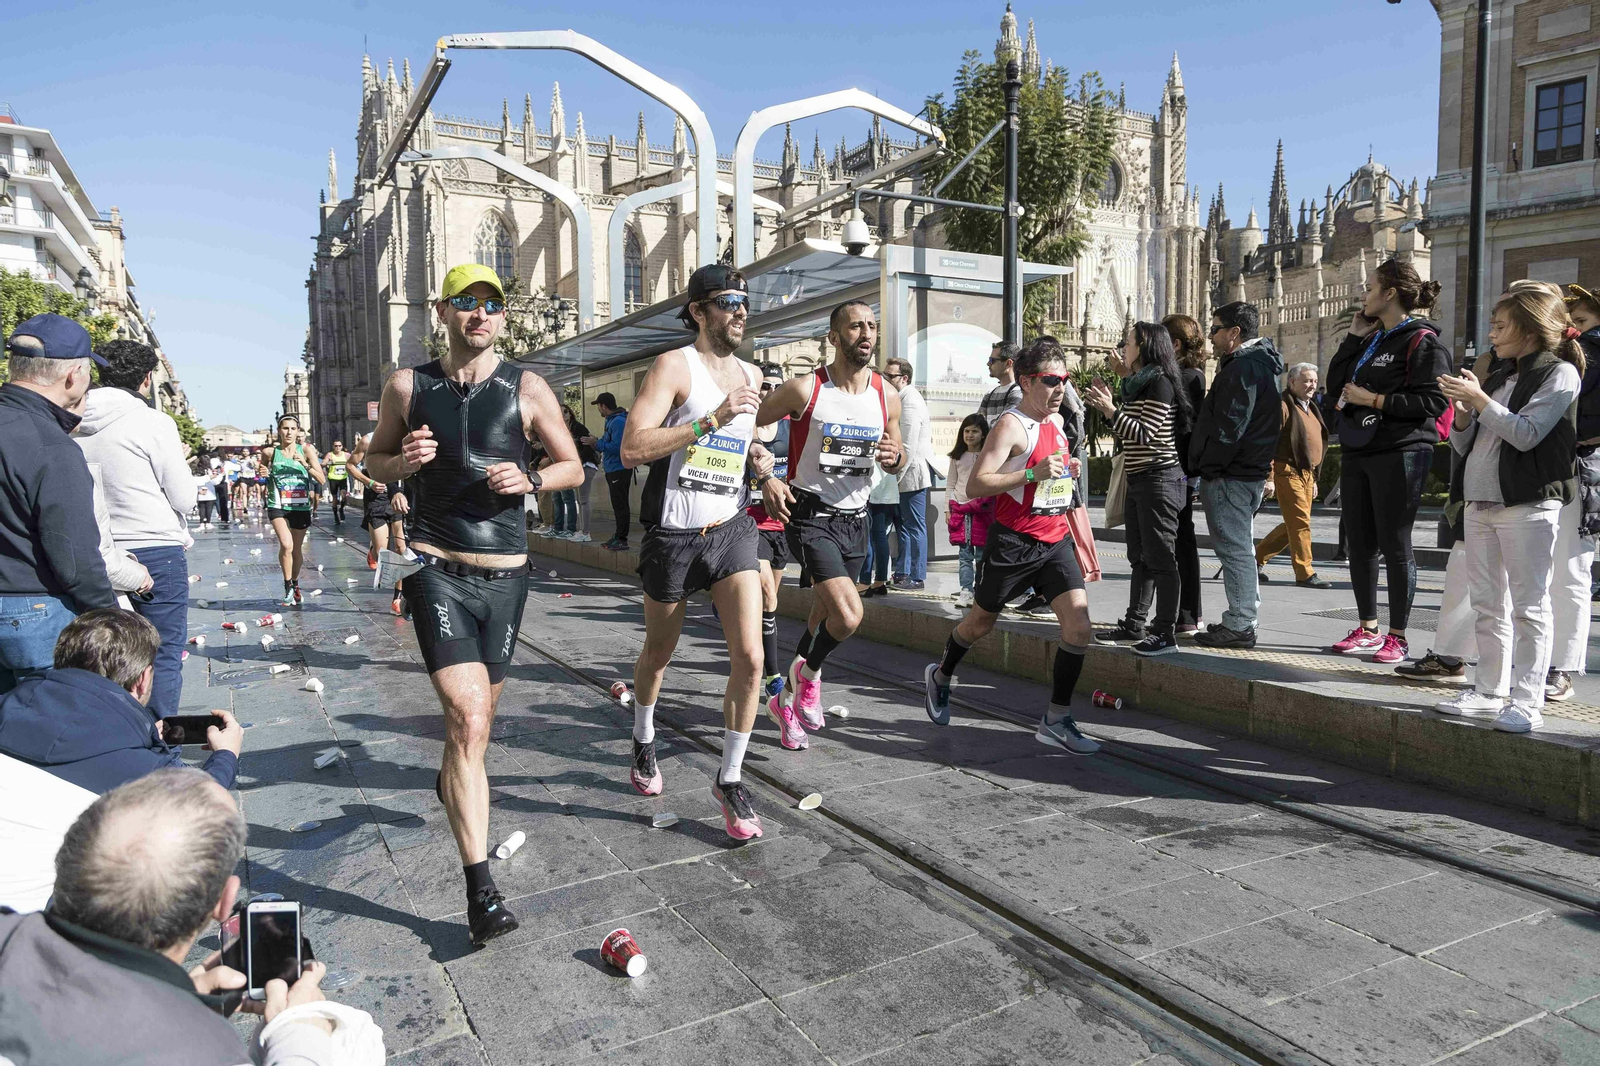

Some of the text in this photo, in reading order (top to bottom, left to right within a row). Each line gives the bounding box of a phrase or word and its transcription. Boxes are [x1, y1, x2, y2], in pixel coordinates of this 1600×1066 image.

[843, 427, 873, 438] ZURICH
[711, 437, 740, 451] ZURICH
[840, 445, 862, 456] 2269
[706, 456, 727, 468] 1093
[687, 468, 735, 484] VICEN FERRER
[1051, 485, 1065, 494] 1525
[1046, 498, 1066, 506] ALBERTO
